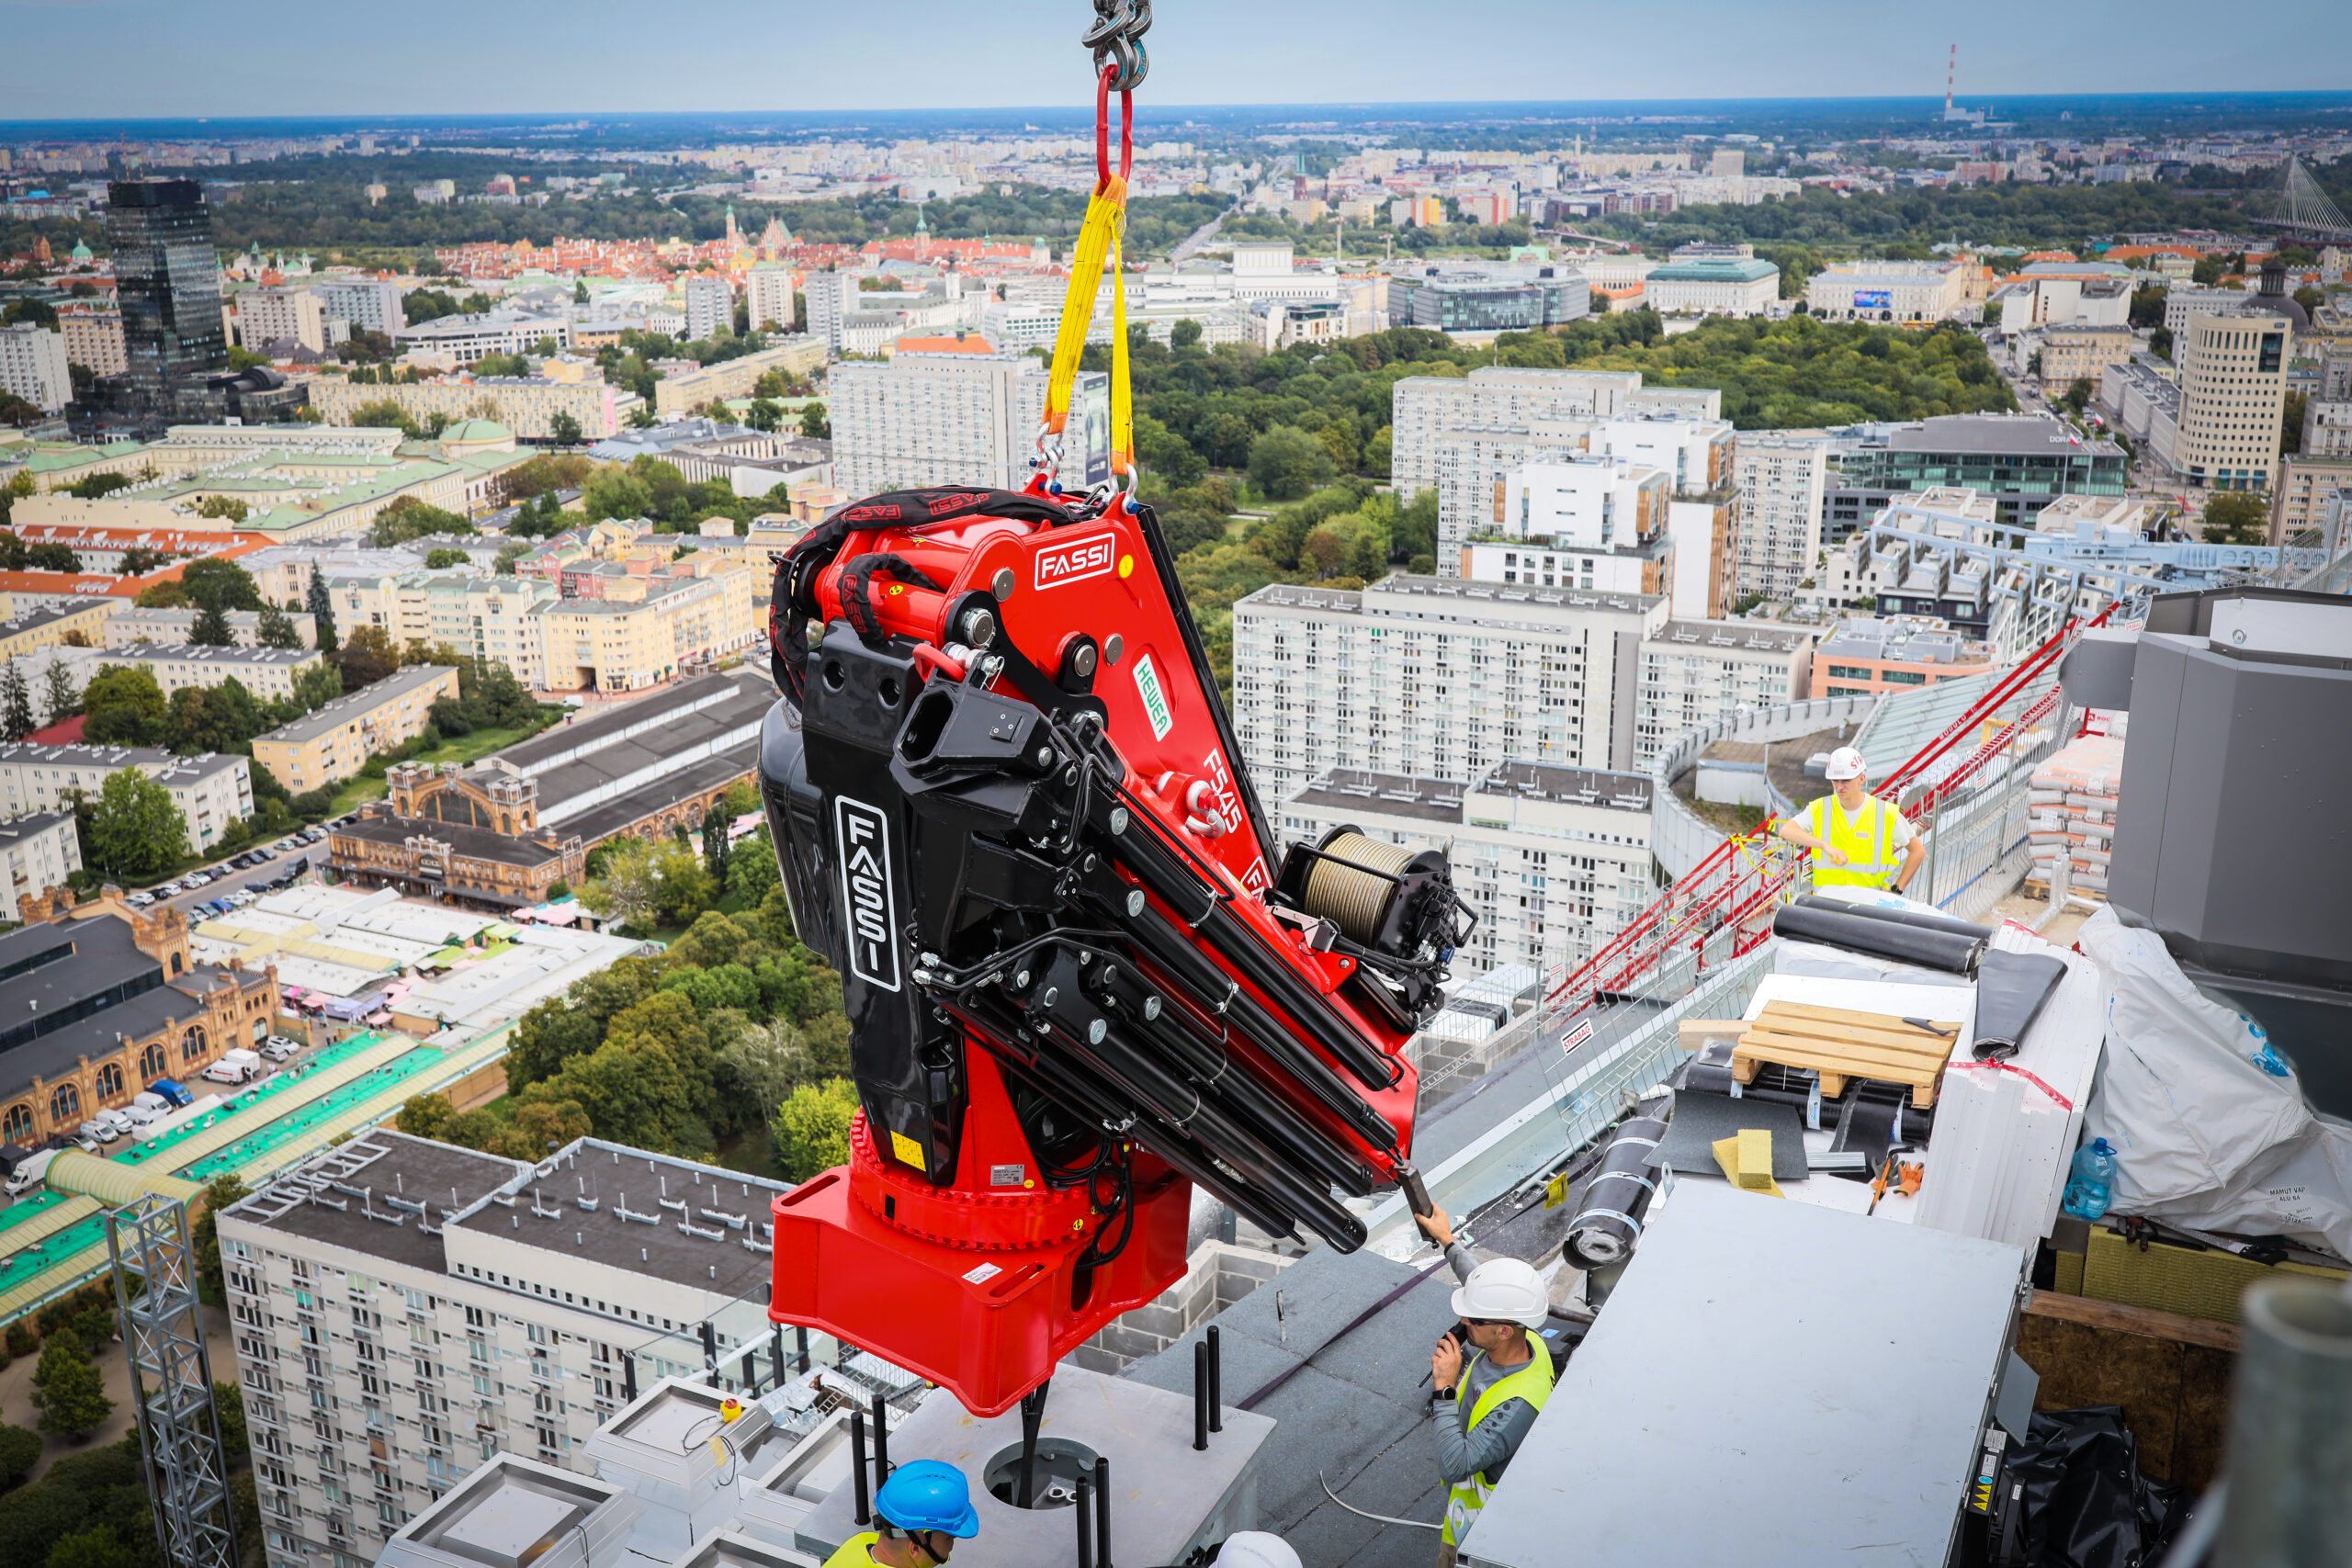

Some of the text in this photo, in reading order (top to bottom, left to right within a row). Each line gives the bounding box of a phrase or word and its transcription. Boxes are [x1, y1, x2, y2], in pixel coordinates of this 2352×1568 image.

[1041, 544, 1108, 579] FASSI
[842, 577, 866, 632] FASSI
[1137, 662, 1168, 733] HEWEA
[1203, 748, 1243, 834] F545
[848, 813, 884, 972] FASSI
[1563, 1025, 1590, 1050] STRABAG
